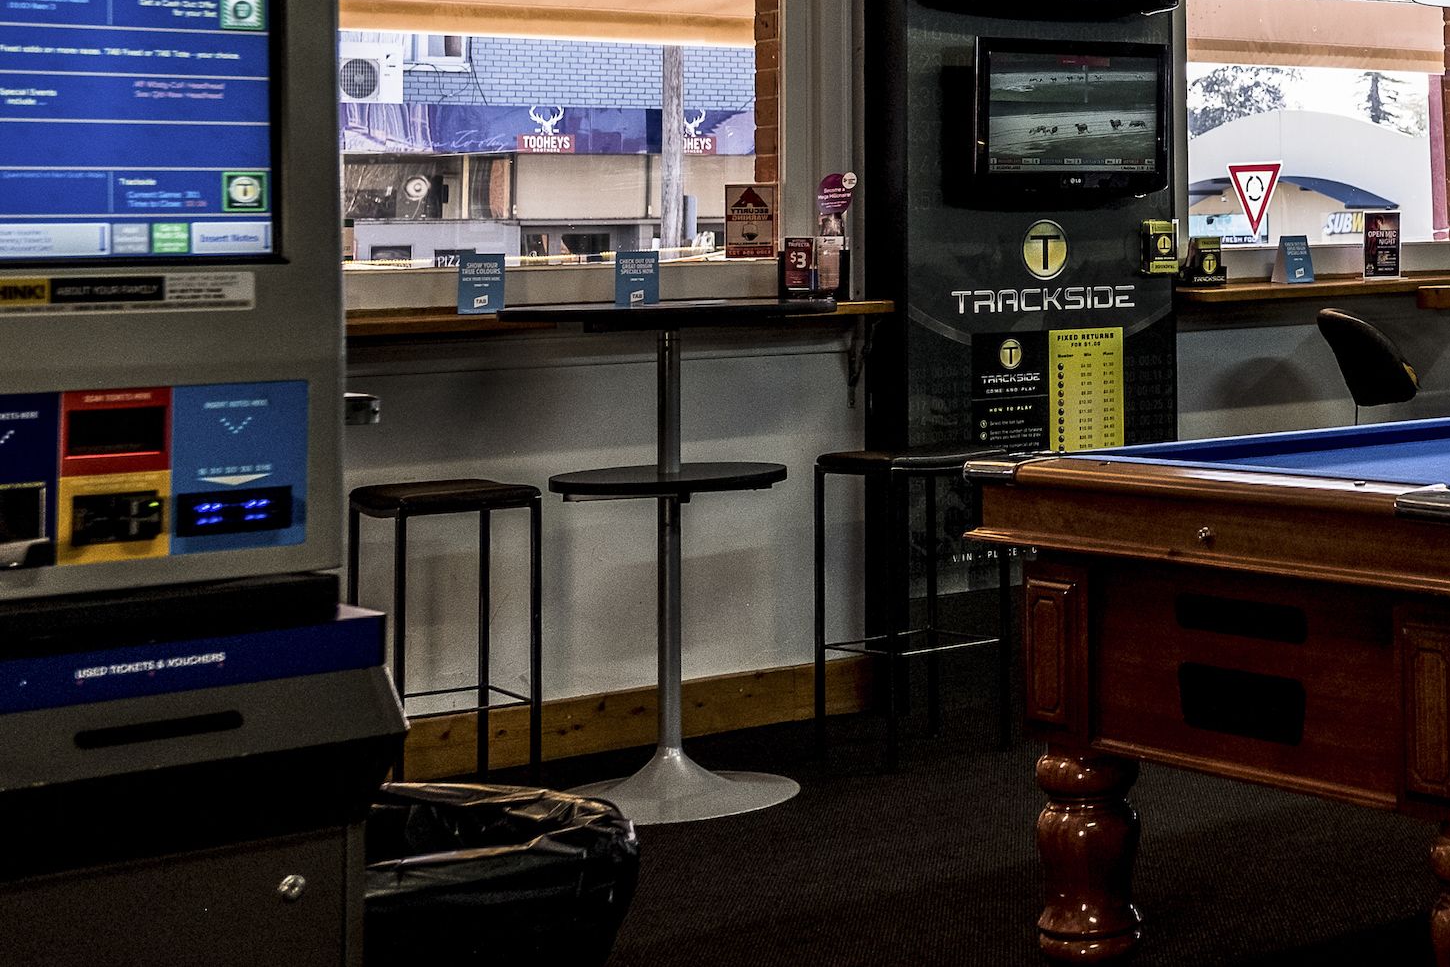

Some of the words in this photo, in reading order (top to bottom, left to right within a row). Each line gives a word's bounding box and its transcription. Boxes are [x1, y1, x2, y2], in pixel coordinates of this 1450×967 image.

[31, 89, 57, 98] Events
[523, 136, 570, 149] TOOHEYS
[201, 234, 230, 243] Insert
[232, 234, 259, 243] Notes
[1368, 230, 1384, 238] OPEN
[1385, 230, 1397, 238] MIC
[1030, 235, 1060, 270] T
[790, 251, 807, 269] $3
[951, 285, 1135, 314] TRACKSIDE
[981, 373, 1040, 384] TRACKSIDE
[75, 666, 107, 680] USED
[108, 660, 155, 675] TICKETS
[166, 651, 226, 668] VOUCHERS
